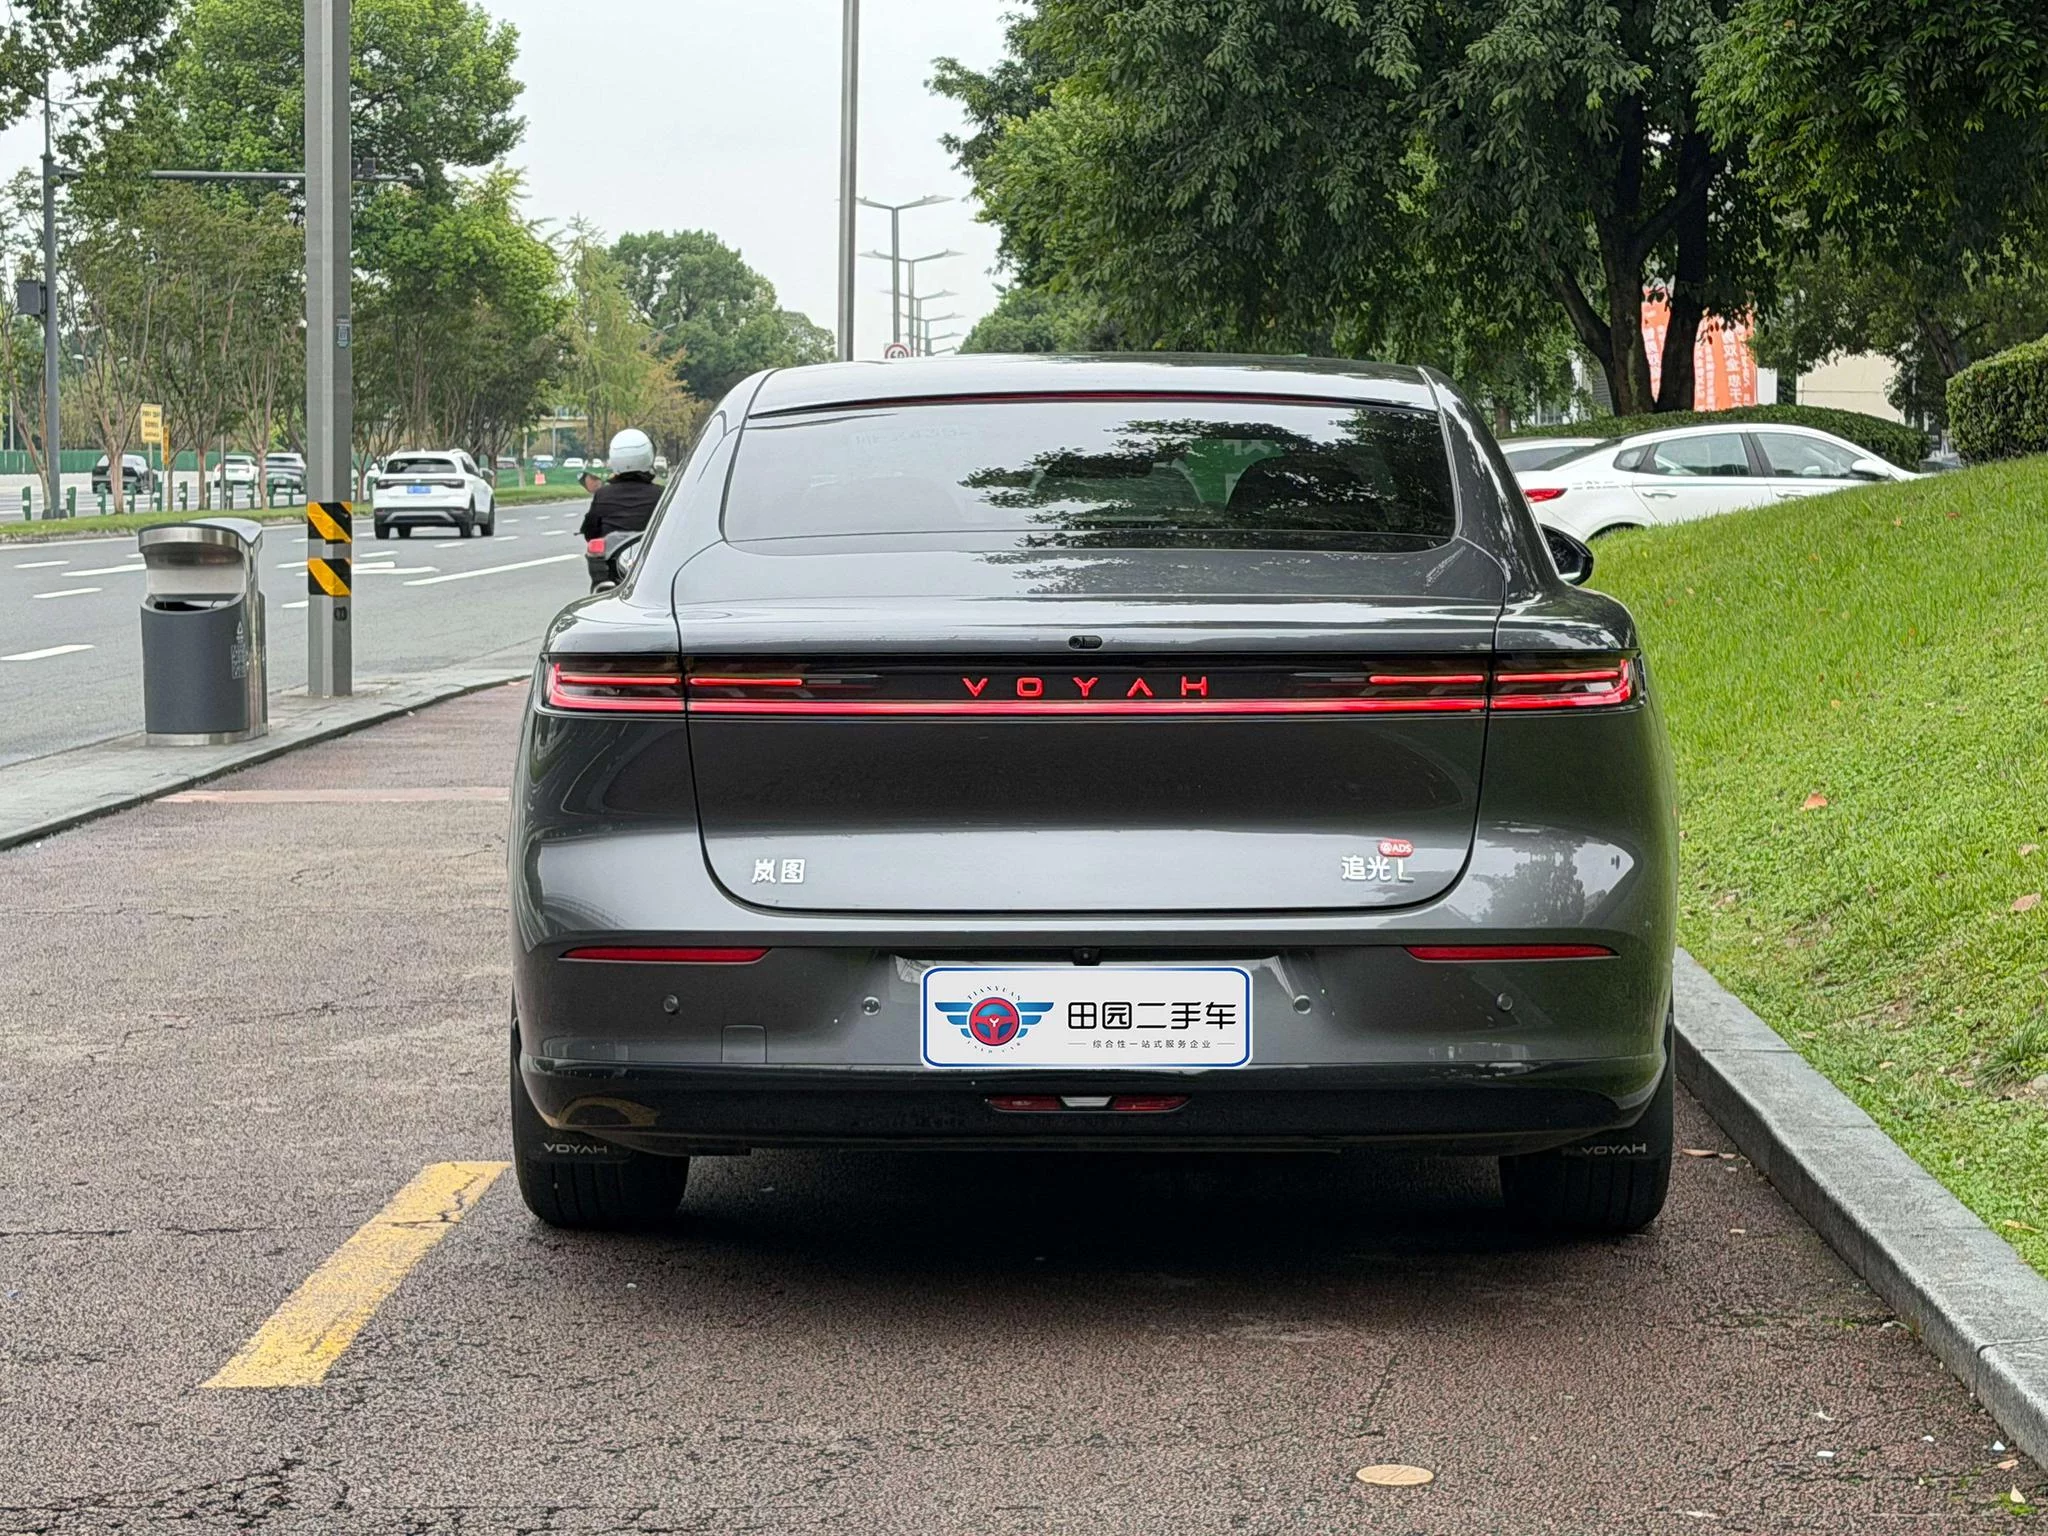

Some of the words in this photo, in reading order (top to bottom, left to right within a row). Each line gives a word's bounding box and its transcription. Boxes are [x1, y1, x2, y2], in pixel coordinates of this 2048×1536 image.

[962, 676, 1208, 697] VOYAH
[751, 858, 806, 884] 岚图
[543, 1142, 608, 1154] VOYAH
[1581, 1142, 1647, 1155] VOYAH
